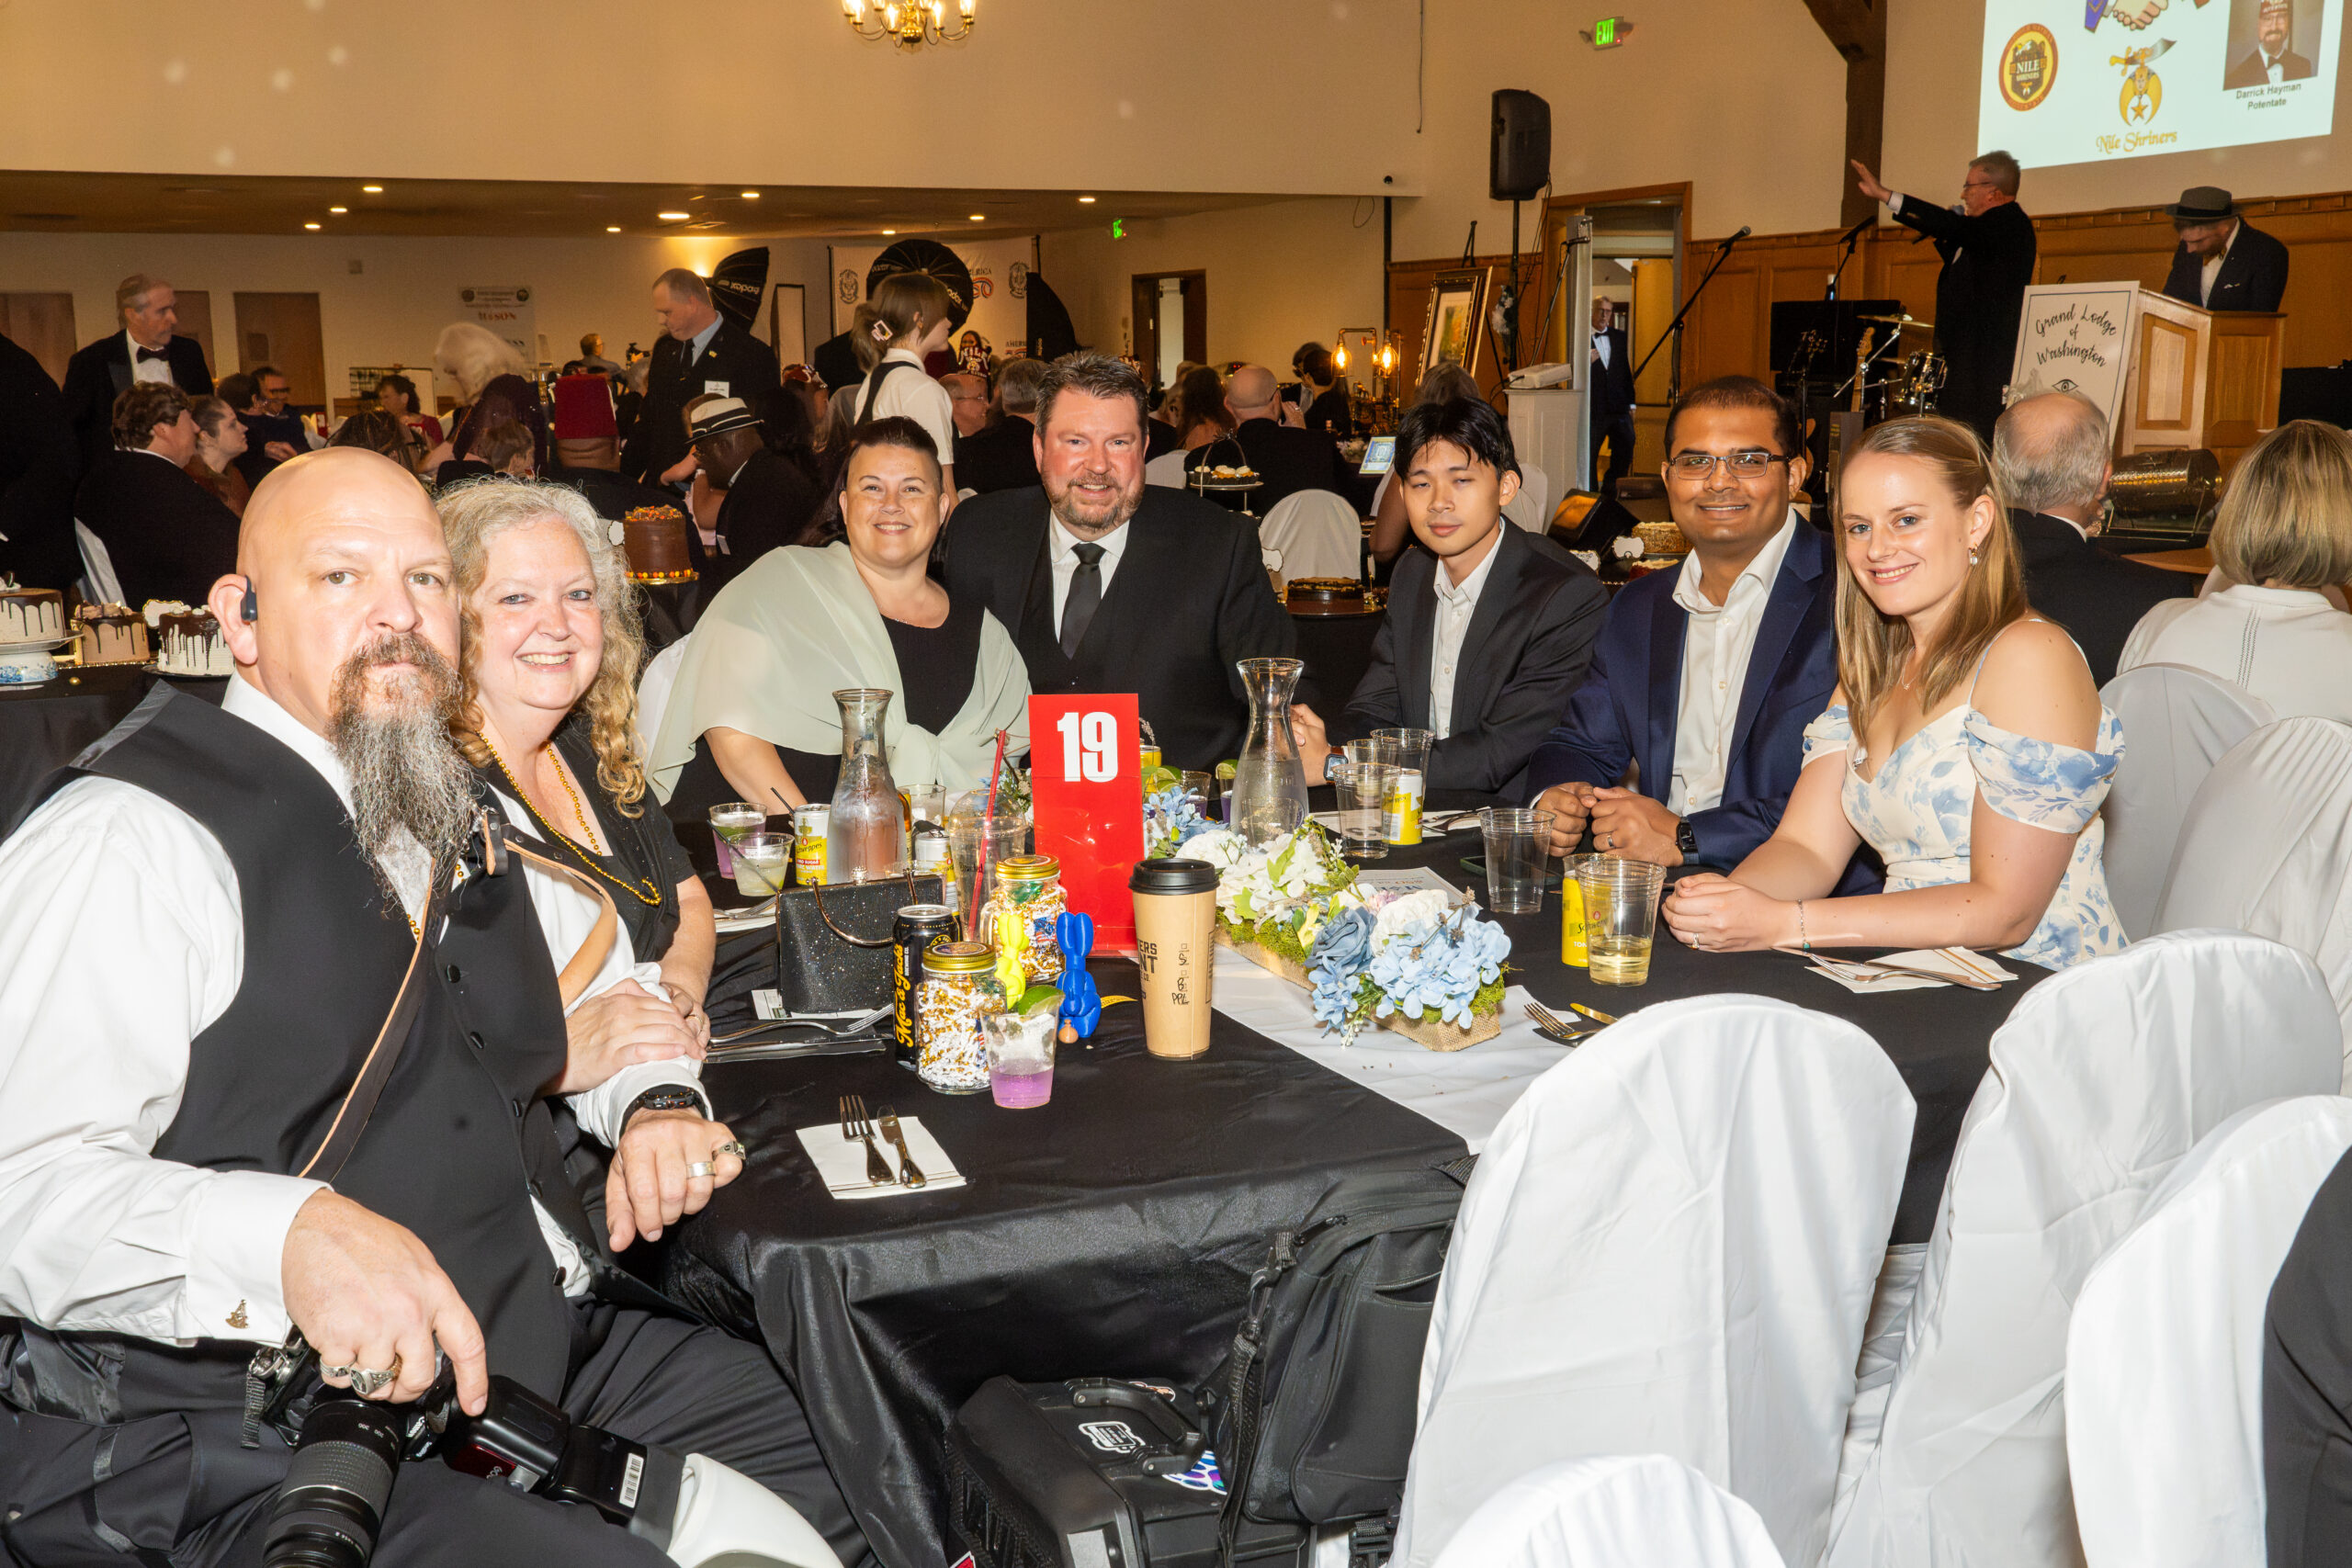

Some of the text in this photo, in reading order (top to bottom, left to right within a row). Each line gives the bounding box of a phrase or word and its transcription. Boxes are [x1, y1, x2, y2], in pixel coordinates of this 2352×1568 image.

[1596, 18, 1615, 46] EXIT
[2017, 59, 2040, 73] NILE
[2236, 83, 2301, 100] Darrick Hayman
[2247, 97, 2287, 110] Potentate
[2096, 130, 2177, 154] Nile Shriners
[2035, 303, 2117, 337] Grand Lodge
[2069, 323, 2079, 340] of
[2036, 340, 2107, 367] Washington
[1057, 711, 1118, 783] 19
[893, 942, 911, 991] Jack's
[895, 991, 914, 1048] Mac
